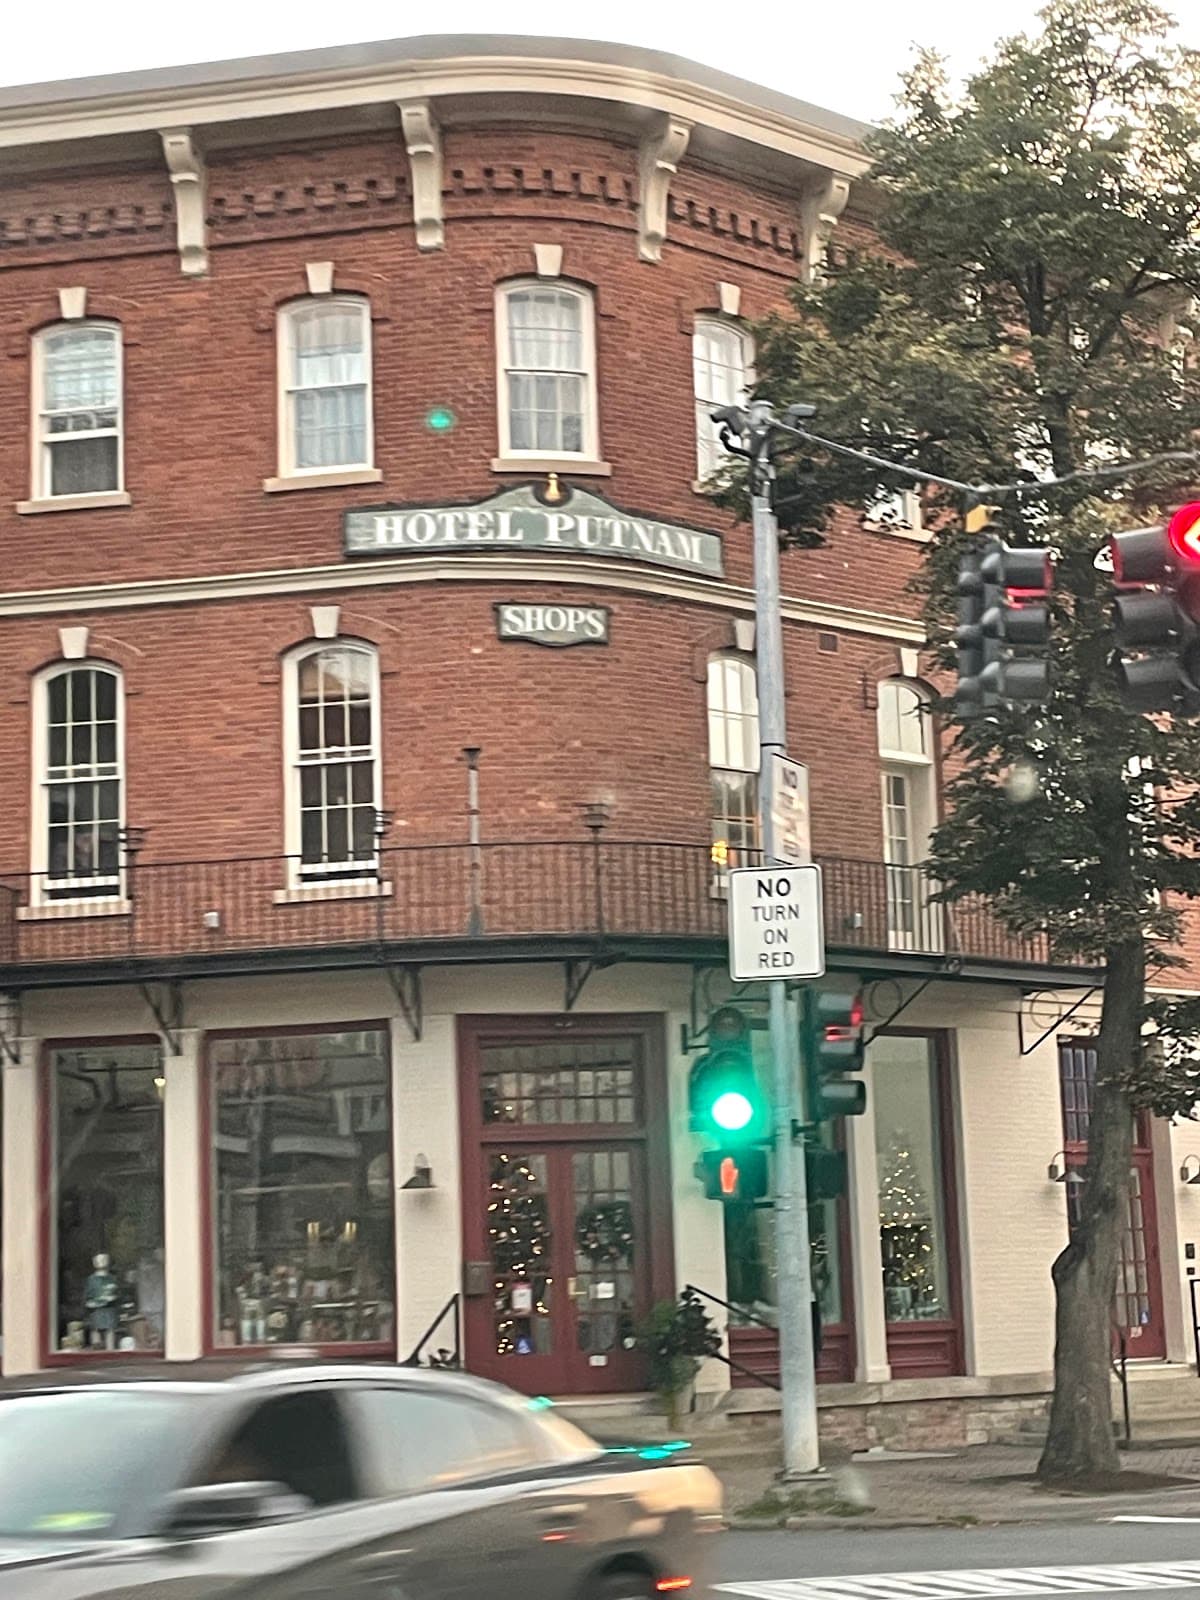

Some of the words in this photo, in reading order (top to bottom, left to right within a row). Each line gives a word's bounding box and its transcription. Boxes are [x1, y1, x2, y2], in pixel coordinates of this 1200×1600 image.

[373, 511, 524, 546] HOTEL
[543, 512, 704, 564] PUTNAM
[503, 607, 606, 636] SHOPS
[757, 878, 791, 898] NO
[752, 904, 800, 922] TURN
[764, 928, 788, 945] ON
[759, 952, 795, 968] RED
